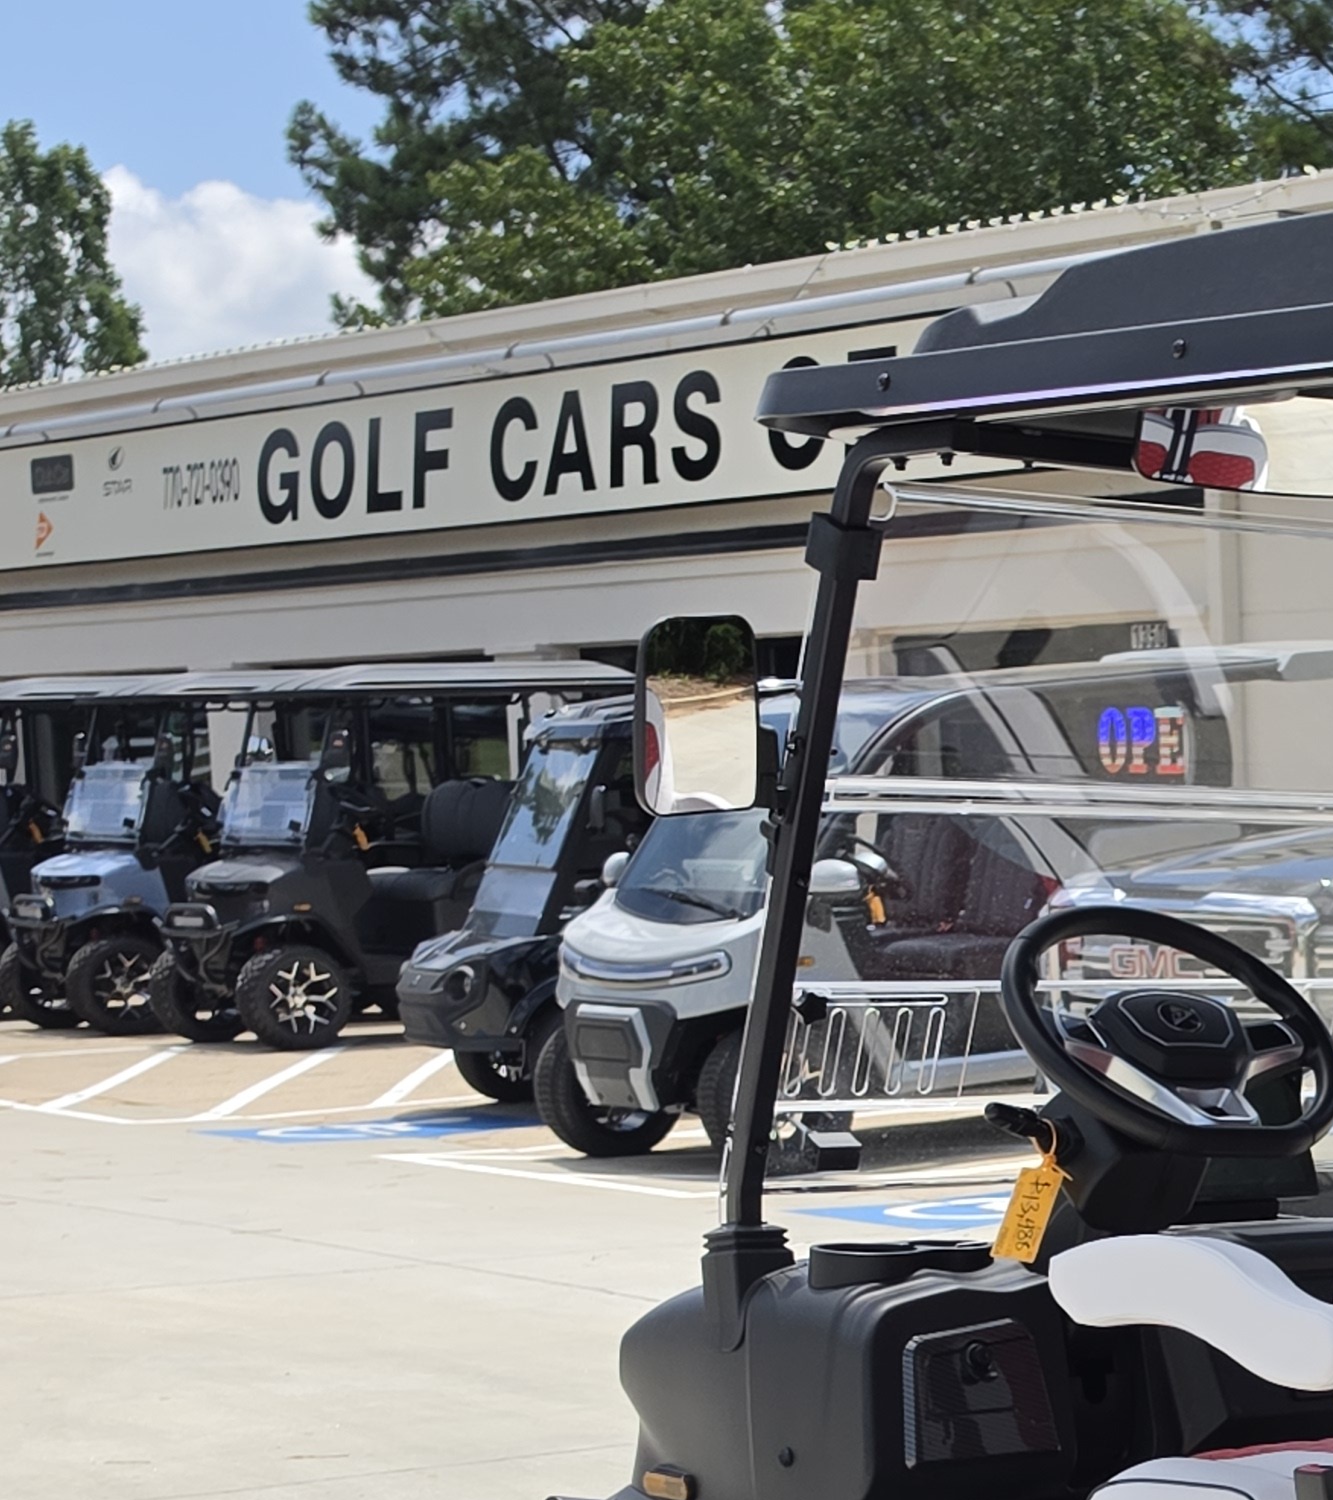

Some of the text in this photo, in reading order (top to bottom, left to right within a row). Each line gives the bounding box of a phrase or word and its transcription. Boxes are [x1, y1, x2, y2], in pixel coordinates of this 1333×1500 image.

[257, 407, 454, 525] GOLF
[490, 369, 722, 503] CARS
[1097, 705, 1185, 775] OPE
[1109, 944, 1204, 978] GMC
